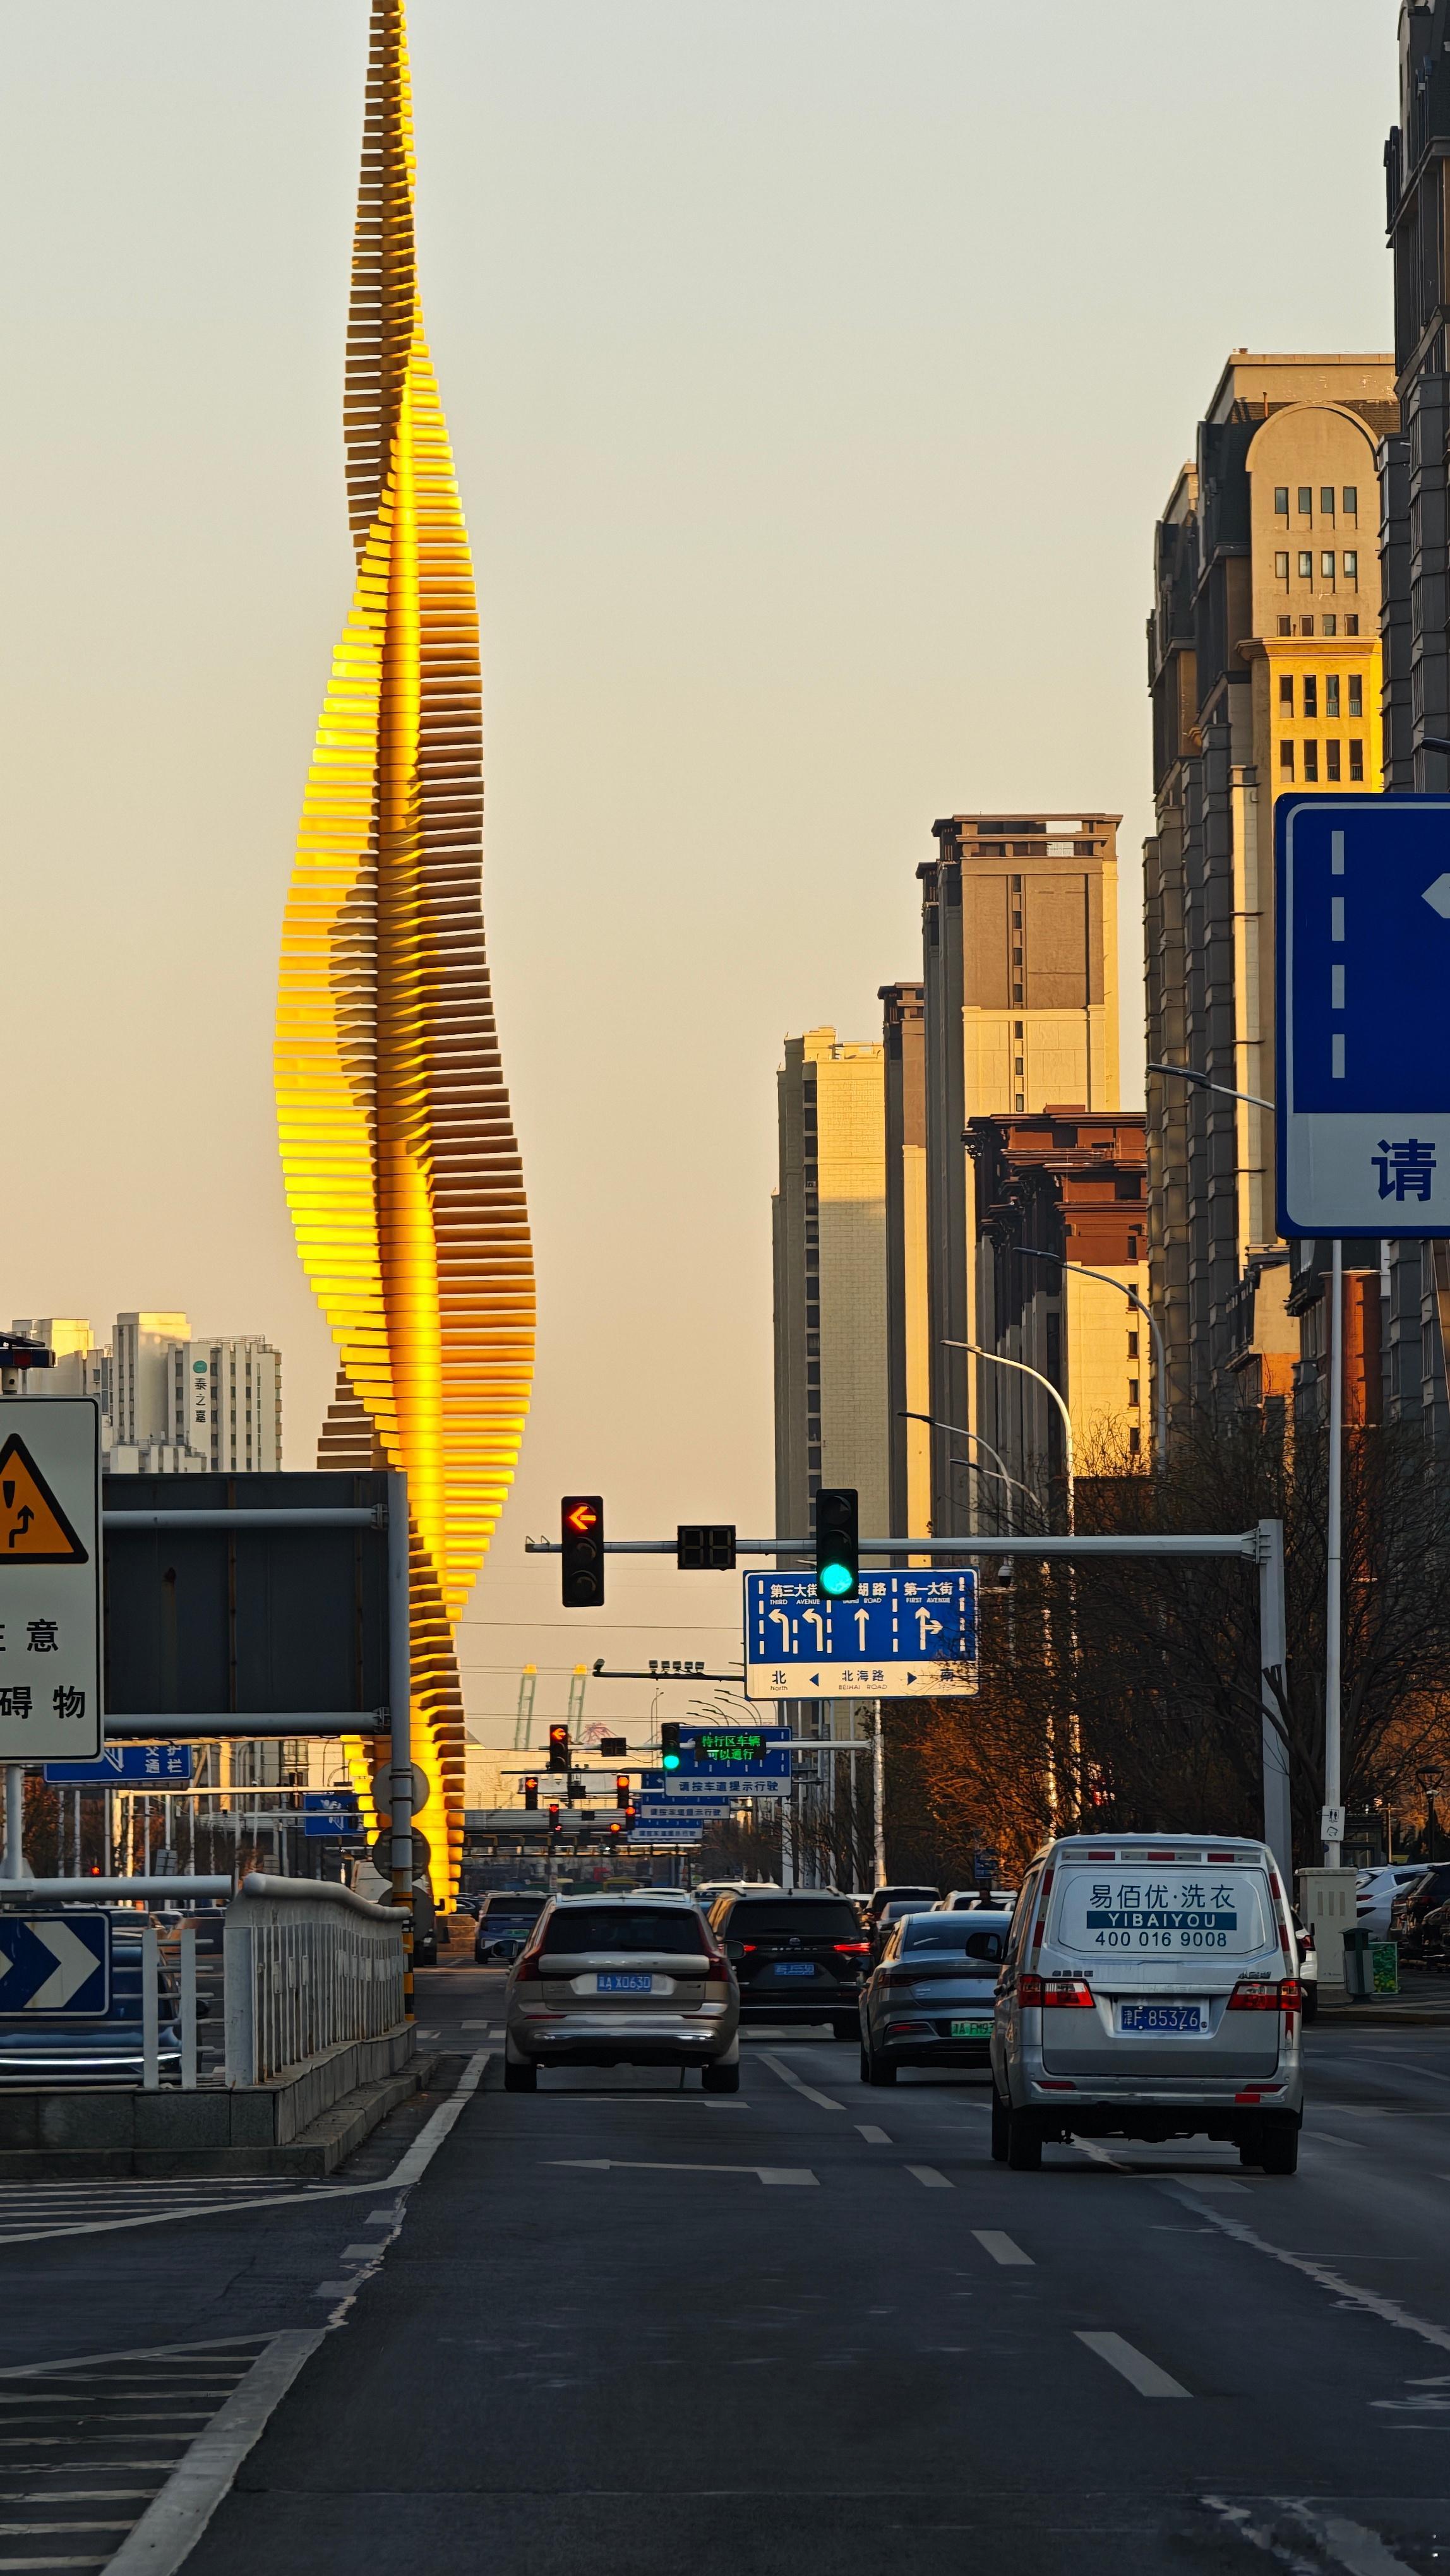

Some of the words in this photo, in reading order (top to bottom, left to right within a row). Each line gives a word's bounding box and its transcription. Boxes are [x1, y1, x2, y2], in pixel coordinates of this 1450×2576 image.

[1371, 1138, 1437, 1202] 请
[770, 1583, 818, 1598] 第三大街
[858, 1583, 887, 1597] 湖路
[904, 1582, 954, 1596] 第一大街
[0, 1618, 59, 1652] 意
[772, 1670, 786, 1685] 北
[842, 1670, 884, 1682] 北海路
[1108, 1913, 1216, 1928] YIBAIYOU
[1095, 1931, 1131, 1947] 400
[1139, 1932, 1171, 1947] 016
[1180, 1932, 1227, 1947] 9008
